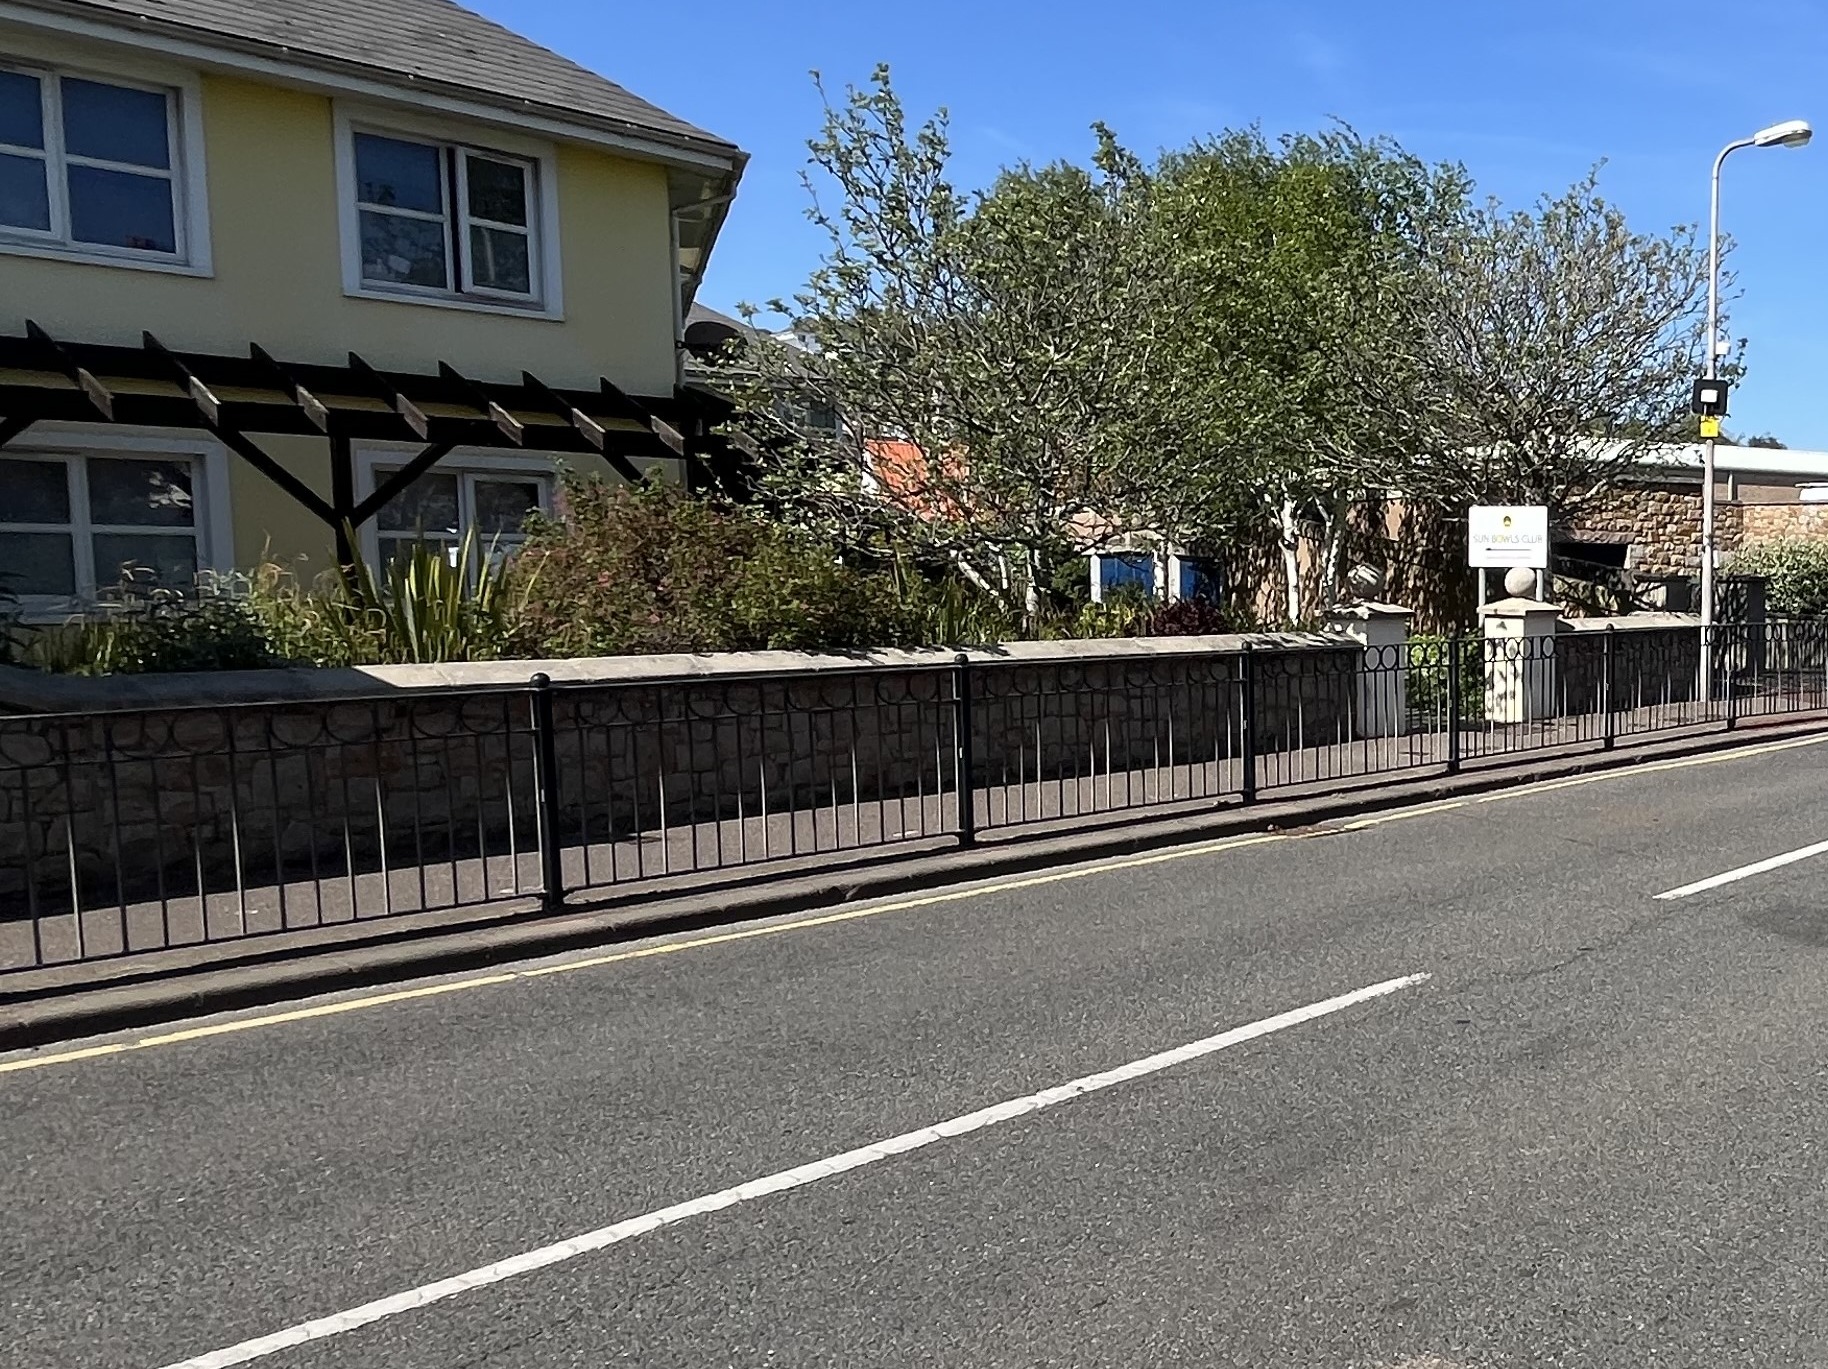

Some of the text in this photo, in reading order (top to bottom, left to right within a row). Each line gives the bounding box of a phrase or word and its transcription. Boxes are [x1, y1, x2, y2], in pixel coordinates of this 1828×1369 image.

[1473, 534, 1543, 543] SUN BOWLS CLUB
